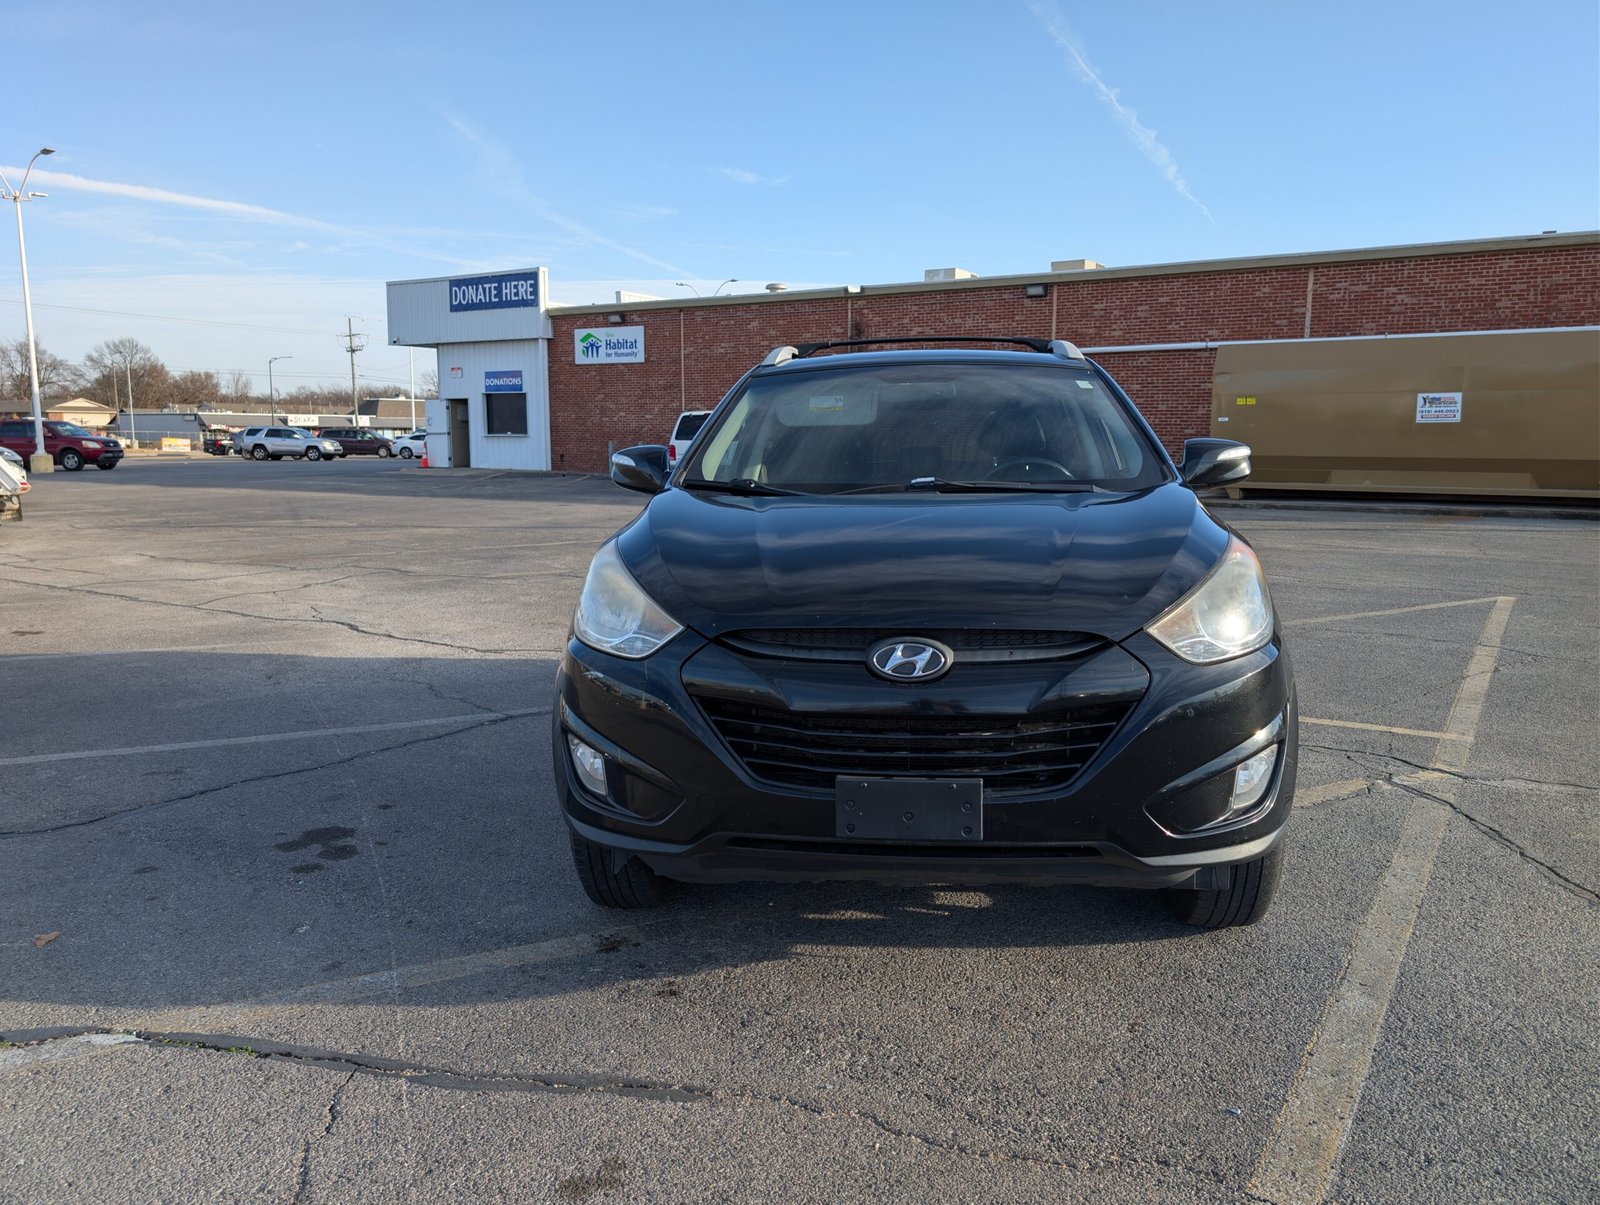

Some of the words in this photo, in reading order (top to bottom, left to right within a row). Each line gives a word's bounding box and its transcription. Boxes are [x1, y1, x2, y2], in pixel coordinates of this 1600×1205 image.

[452, 283, 499, 305] DONATE
[502, 280, 535, 301] HERE
[605, 338, 638, 351] Habitat
[485, 377, 522, 386] DONATIONS
